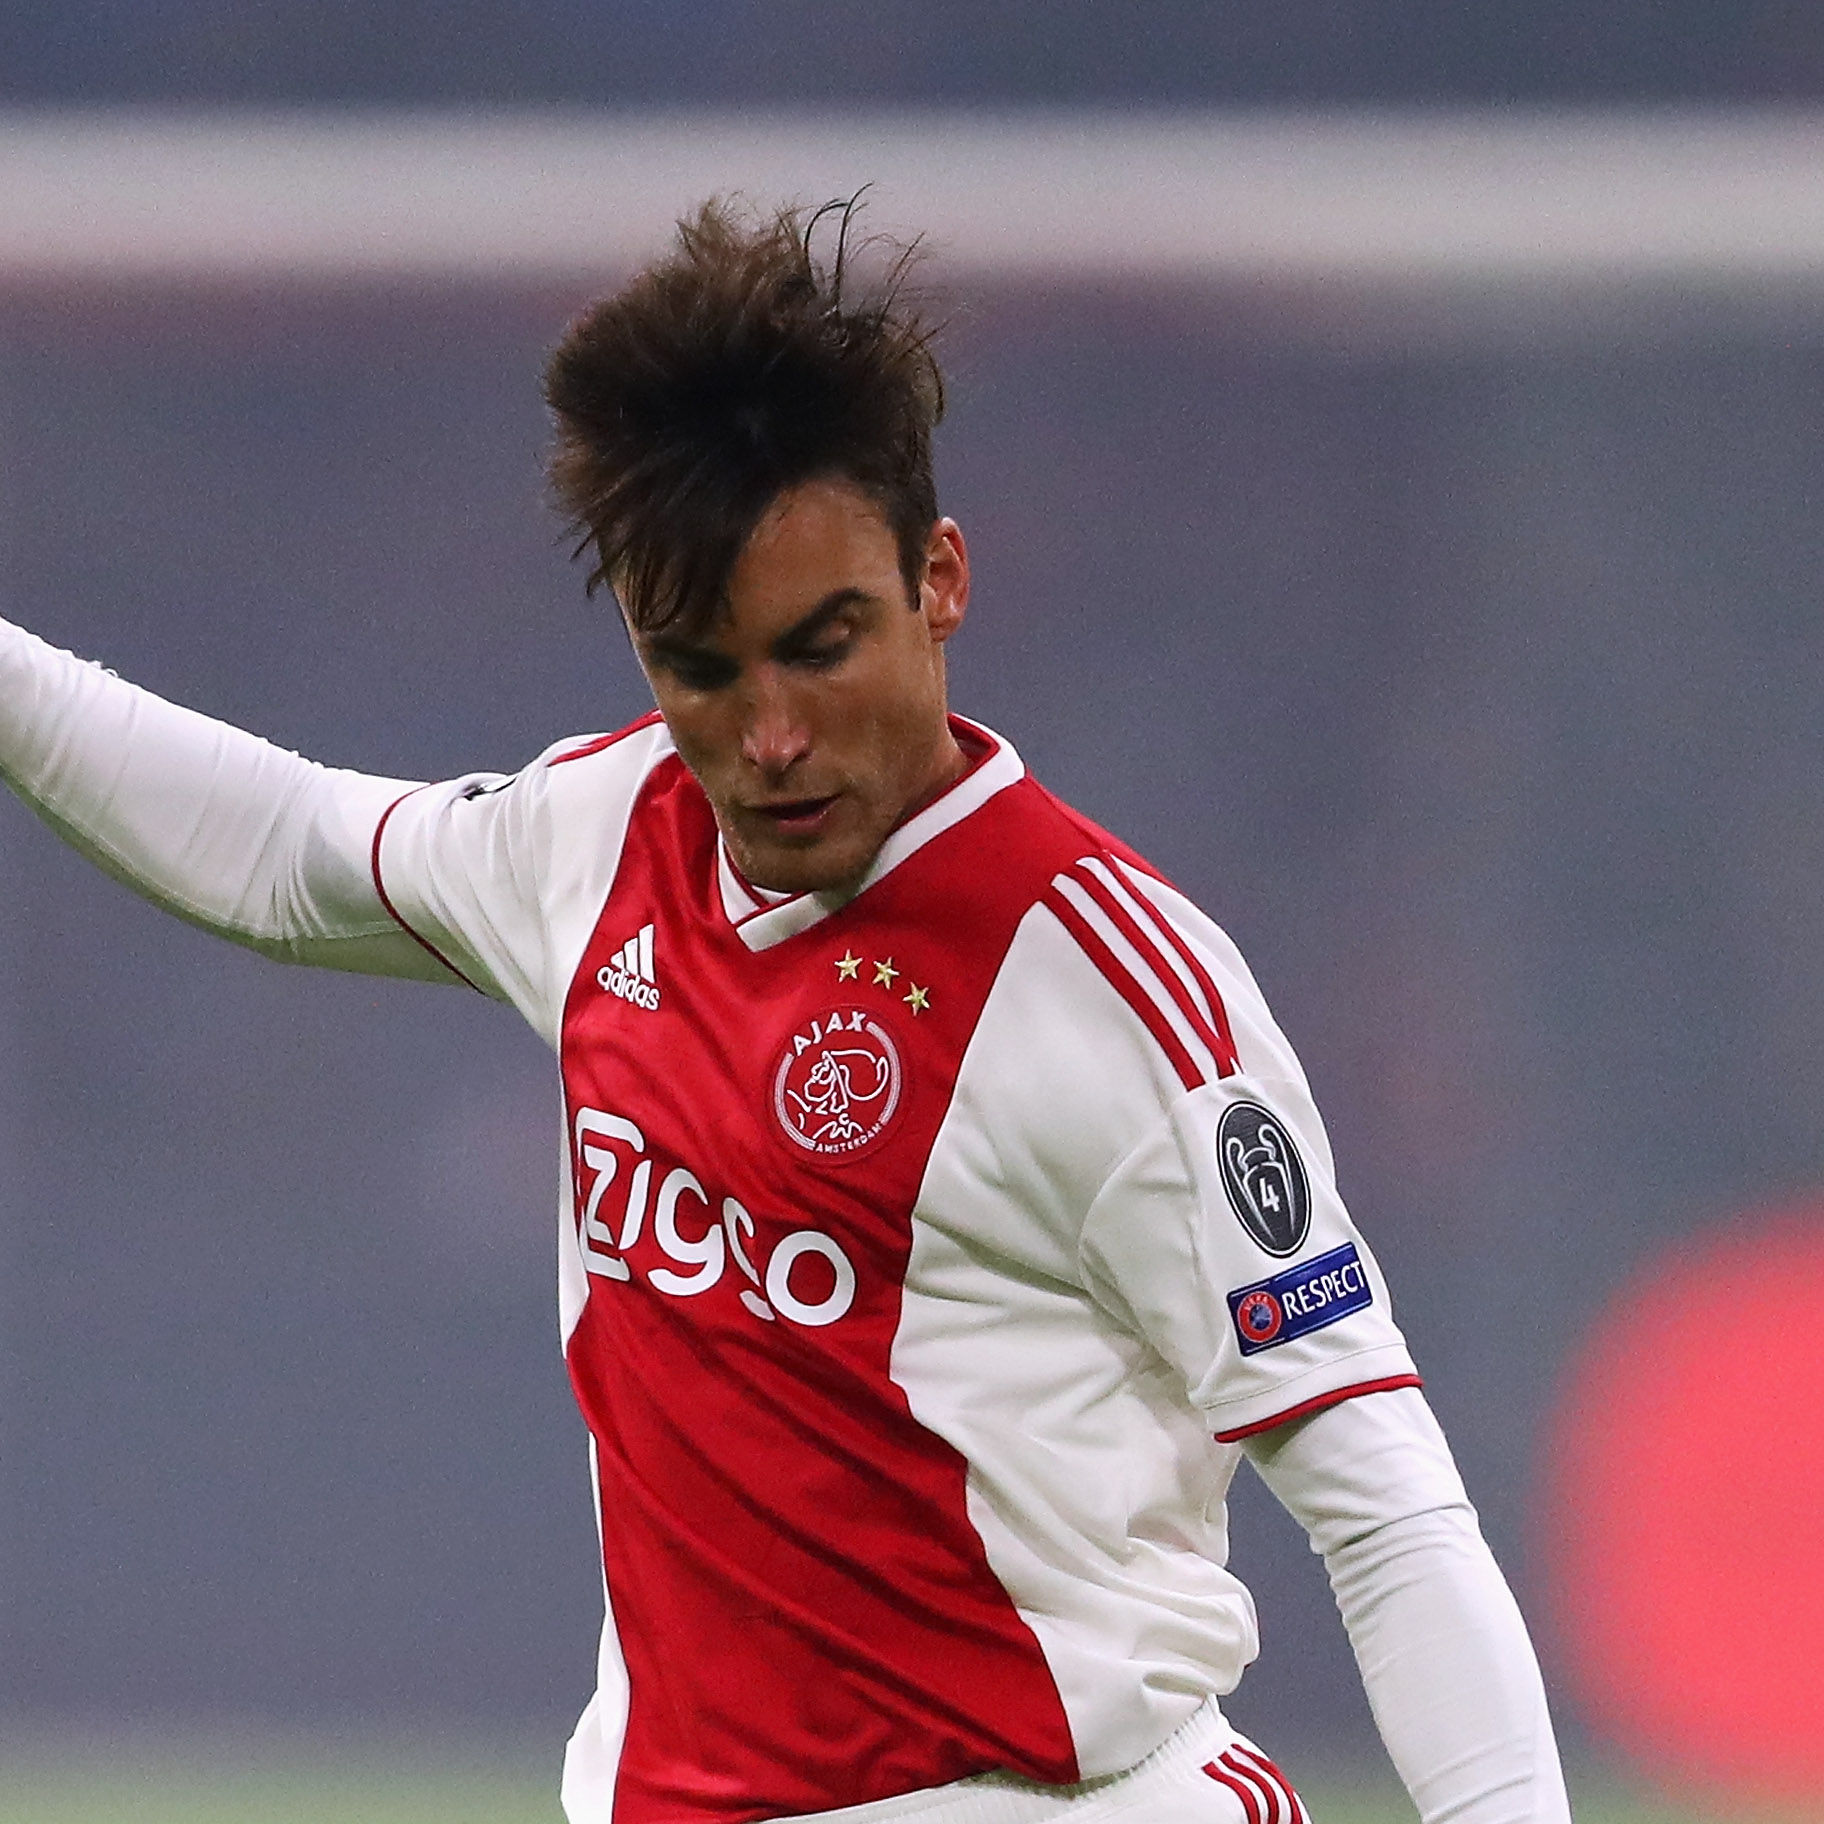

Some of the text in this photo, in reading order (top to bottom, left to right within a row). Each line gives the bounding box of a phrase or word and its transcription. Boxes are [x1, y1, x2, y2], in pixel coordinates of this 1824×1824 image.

[597, 966, 660, 1011] adidas
[793, 1010, 866, 1056] AJAX
[815, 1122, 882, 1153] AMSTERDAM
[1259, 1178, 1280, 1212] 4
[1281, 1260, 1365, 1320] RESPECT
